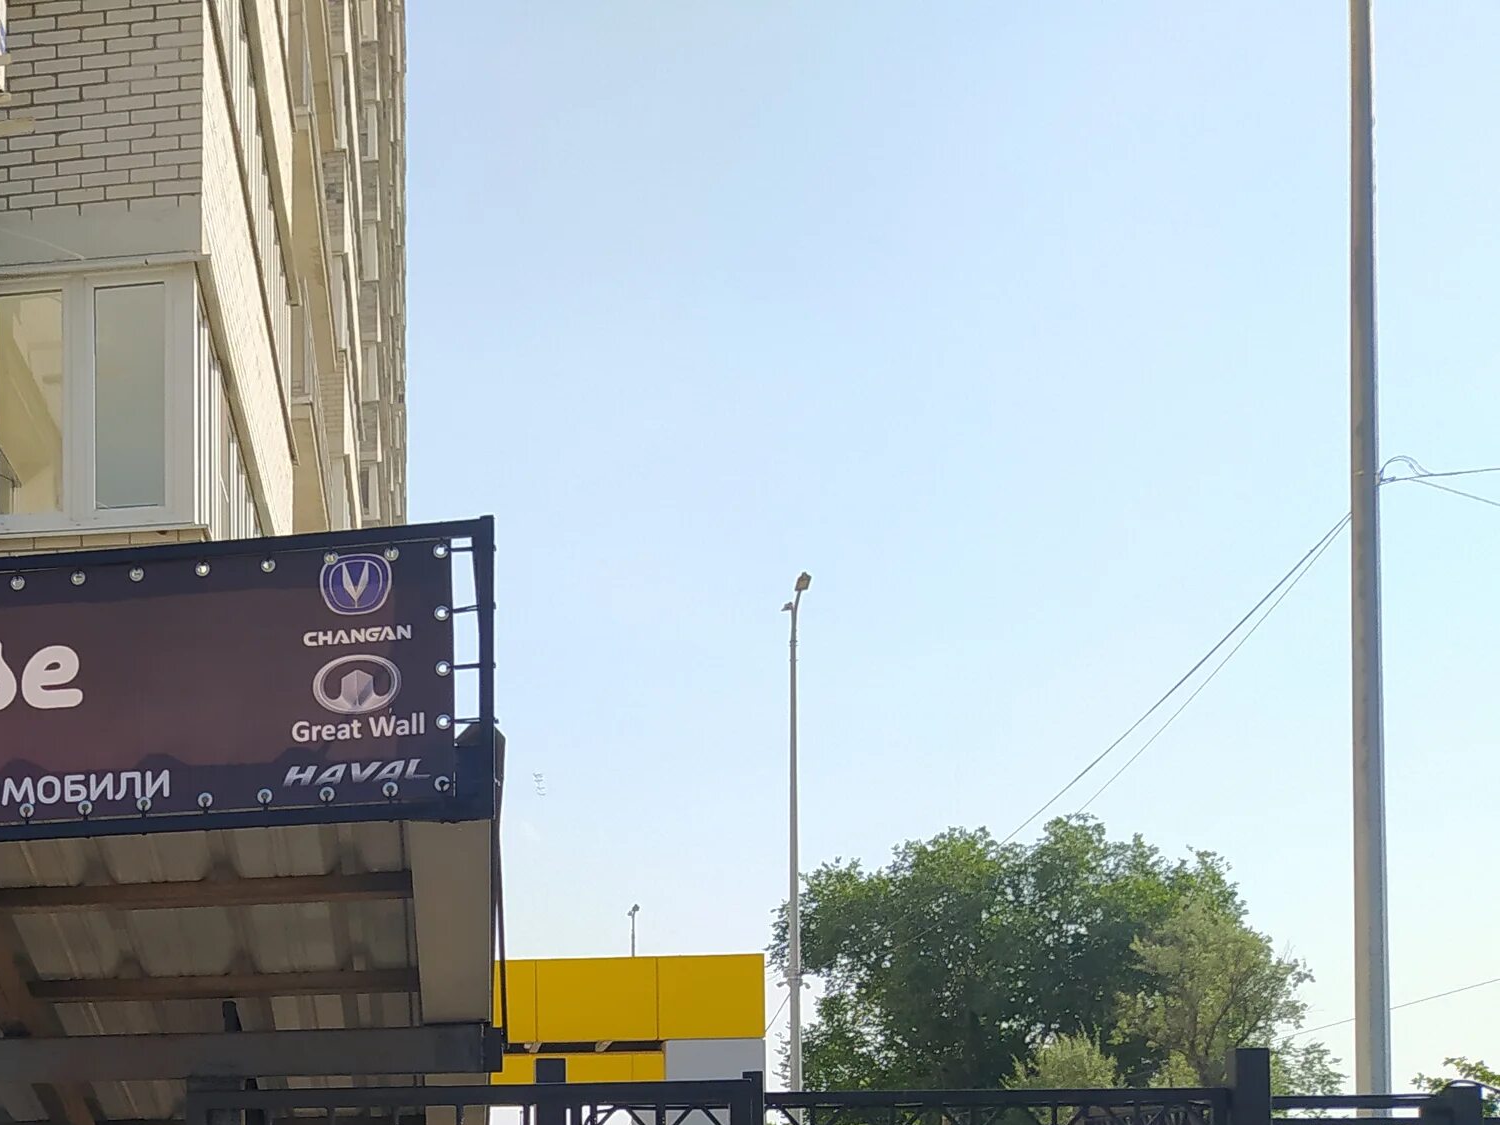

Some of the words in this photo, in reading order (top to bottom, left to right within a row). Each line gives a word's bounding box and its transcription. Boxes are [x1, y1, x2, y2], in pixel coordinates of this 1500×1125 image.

[303, 625, 412, 646] CHANGAN
[291, 717, 361, 744] Great
[367, 712, 426, 739] Wall
[282, 758, 431, 787] HAVAL
